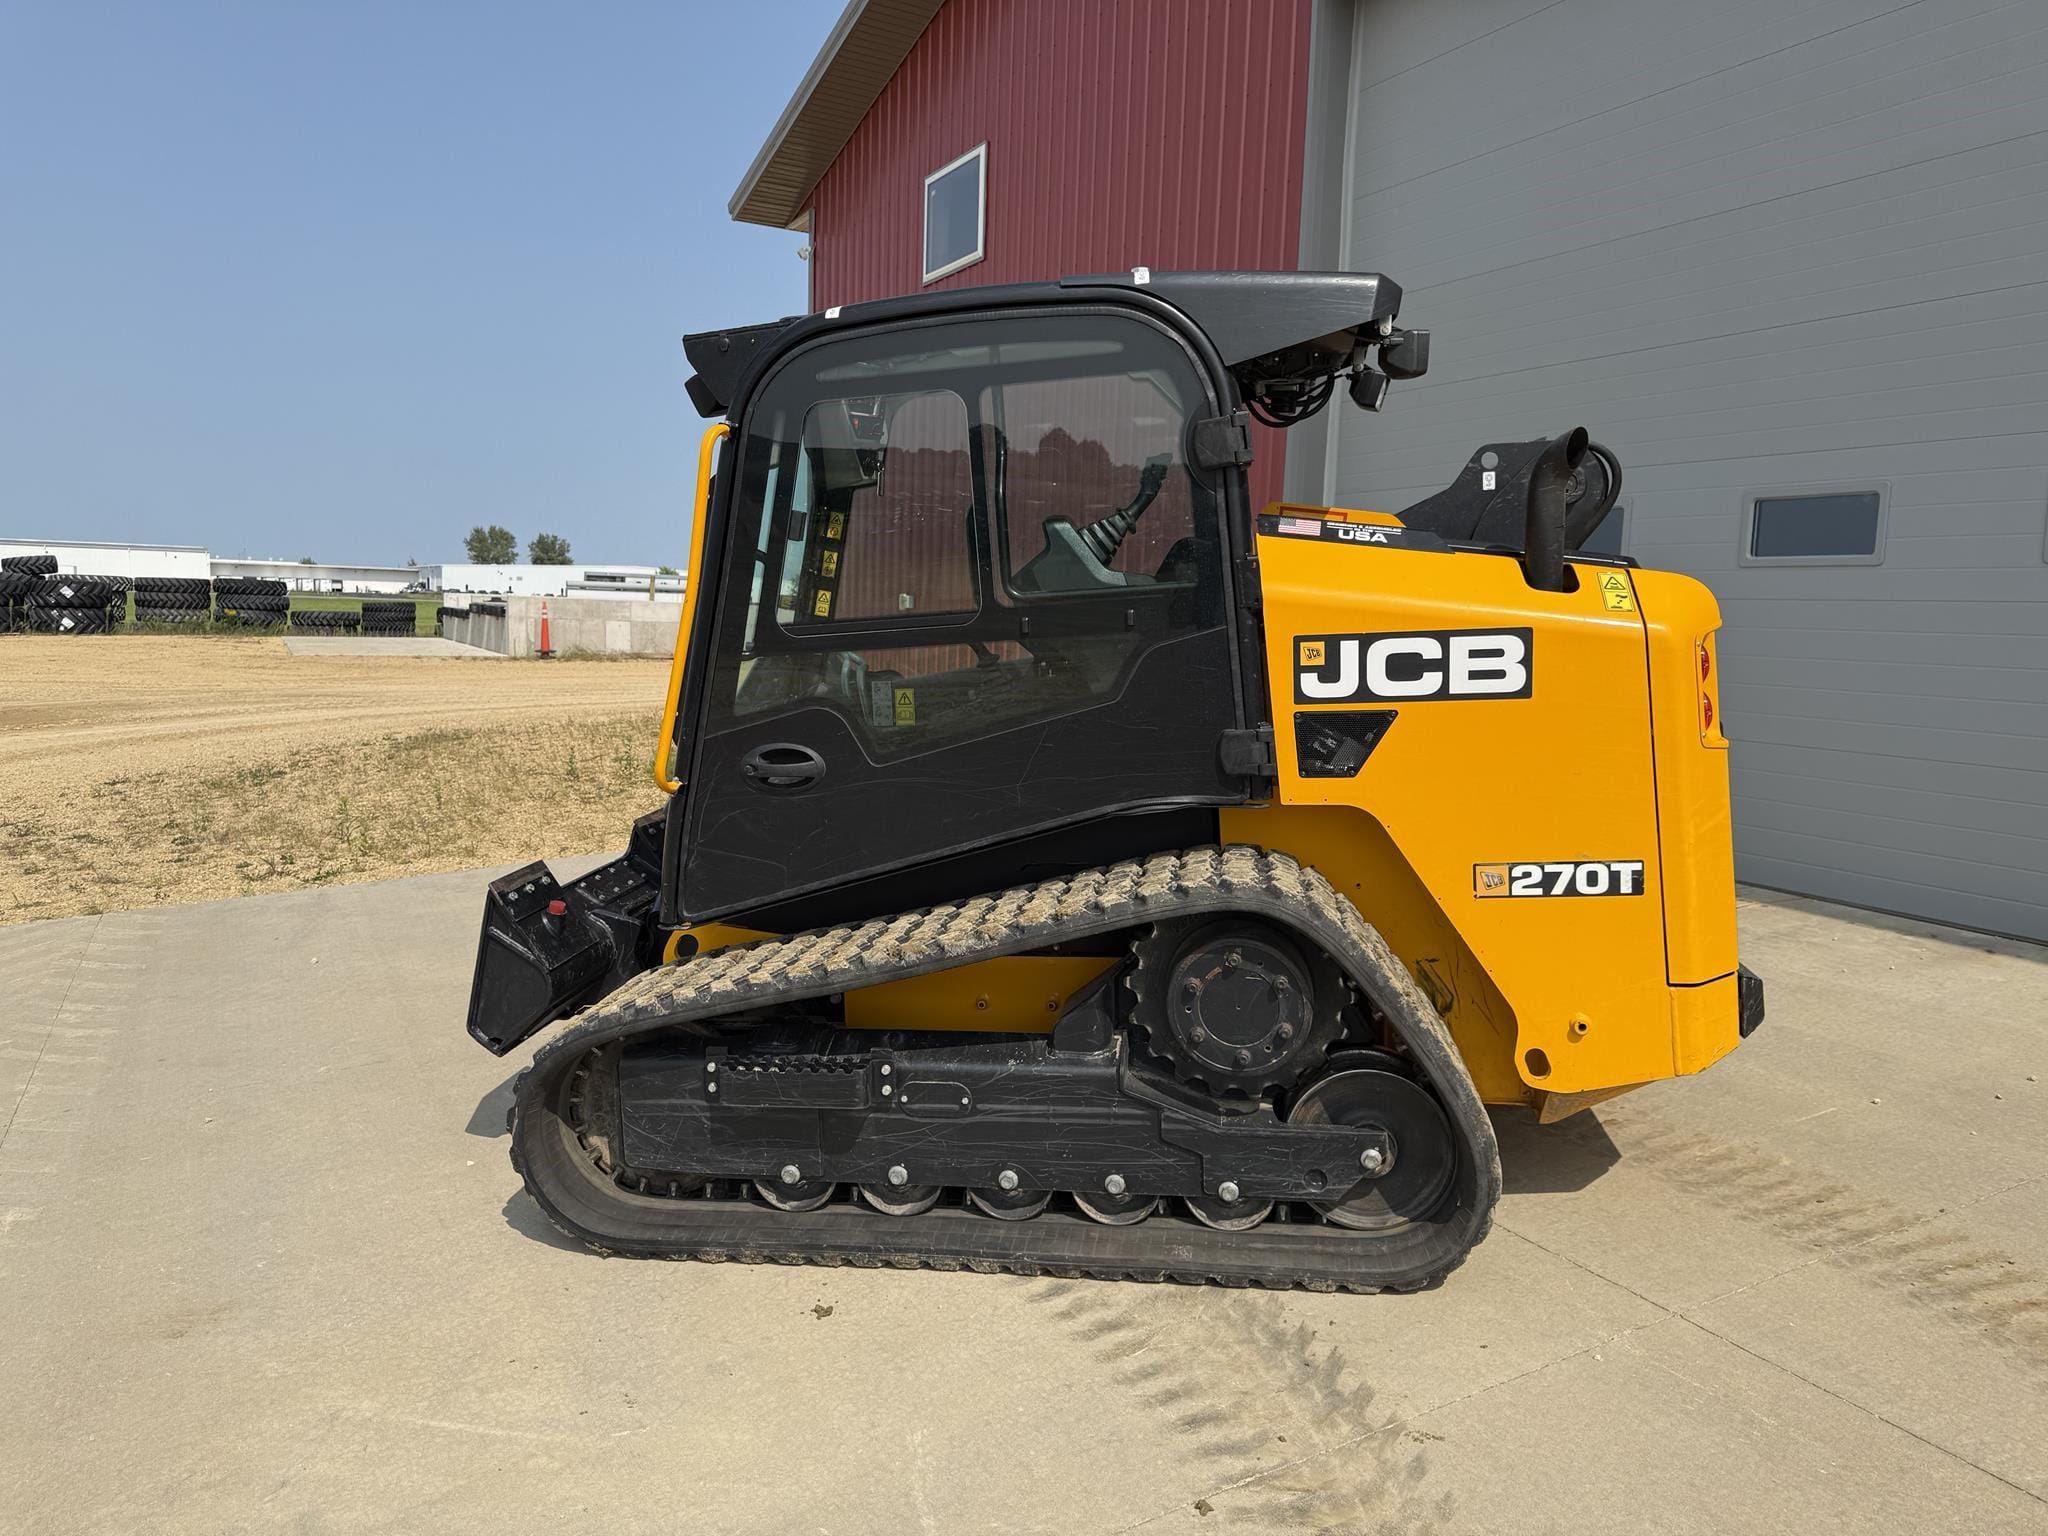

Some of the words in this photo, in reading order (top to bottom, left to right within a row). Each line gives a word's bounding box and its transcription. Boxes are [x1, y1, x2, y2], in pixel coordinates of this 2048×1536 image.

[1338, 529, 1388, 544] USA
[1300, 634, 1527, 698] JCB
[1484, 874, 1504, 888] JCB
[1511, 862, 1643, 896] 270T
